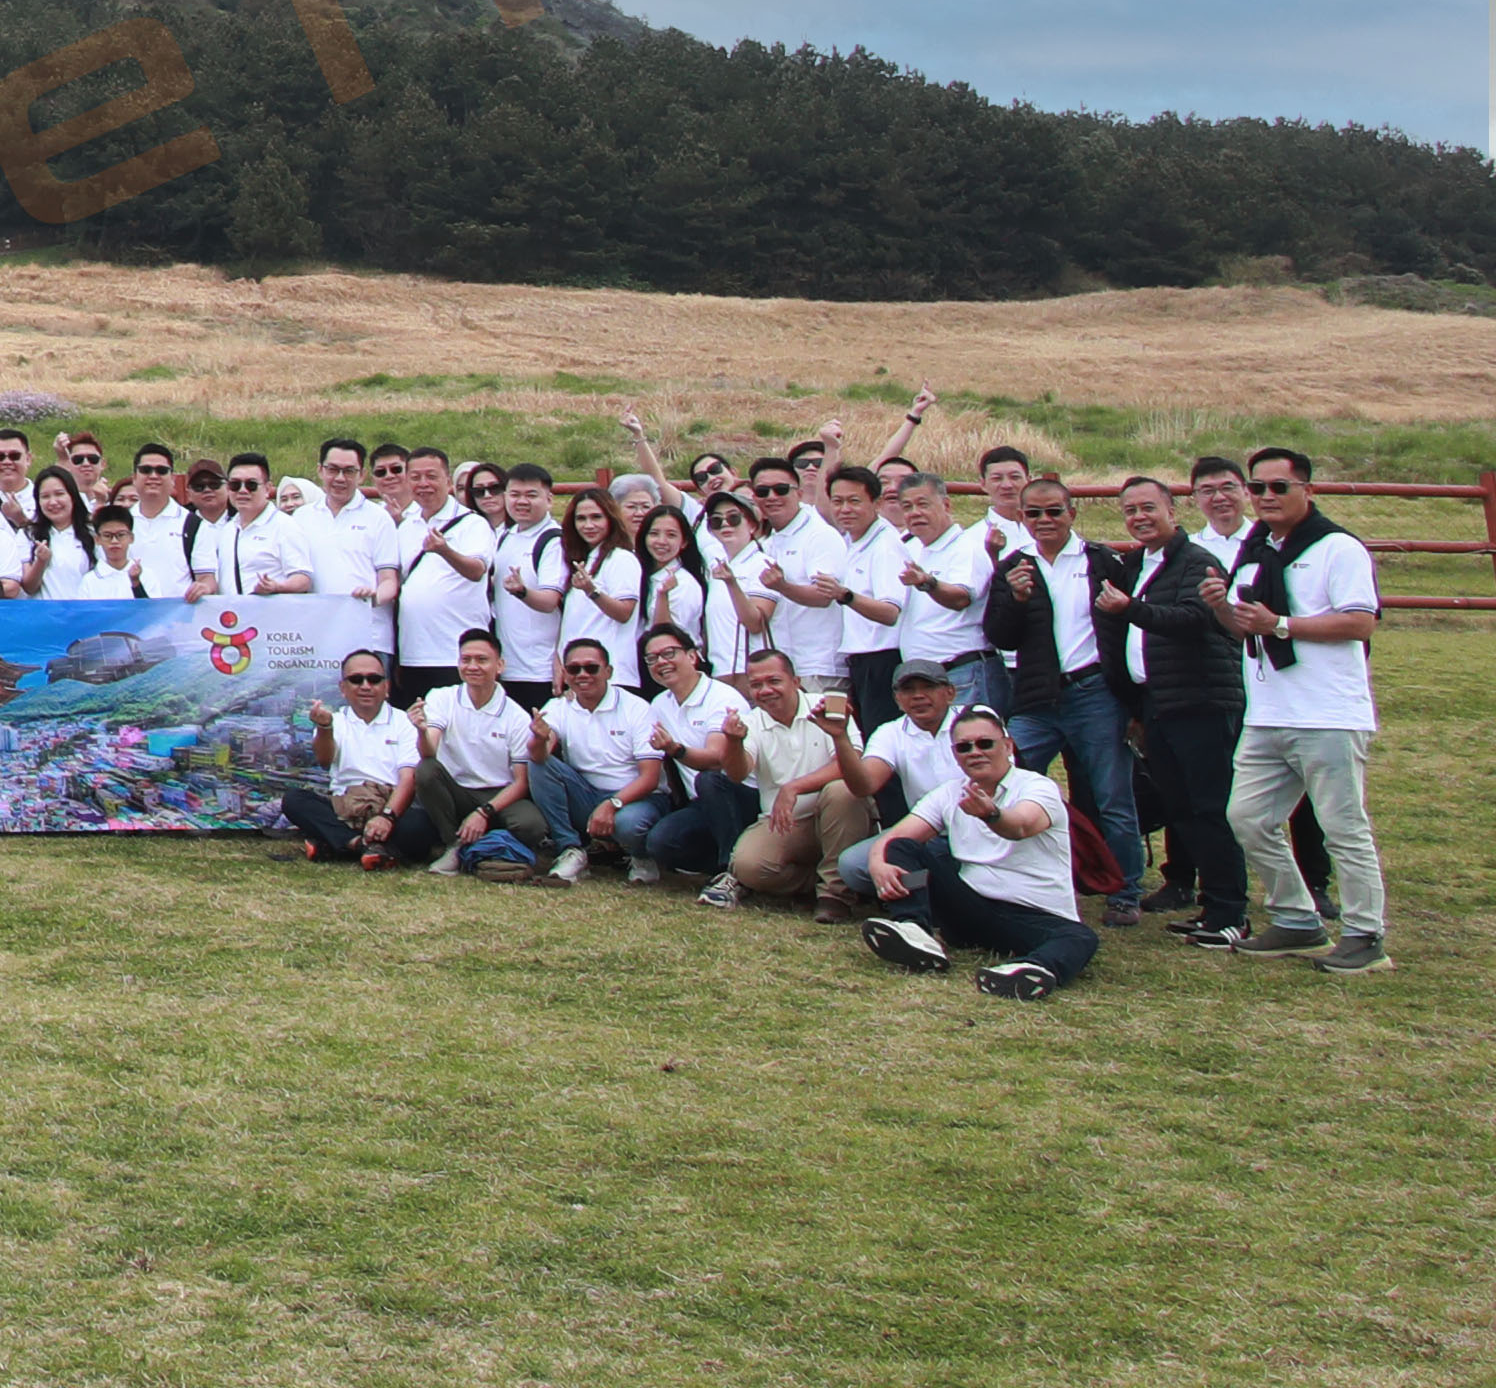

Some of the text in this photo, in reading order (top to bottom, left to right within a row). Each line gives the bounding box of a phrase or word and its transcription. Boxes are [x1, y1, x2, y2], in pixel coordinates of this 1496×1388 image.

[266, 632, 303, 643] KOREA
[267, 646, 315, 656] TOURISM
[268, 659, 344, 670] ORGANIZATIO
